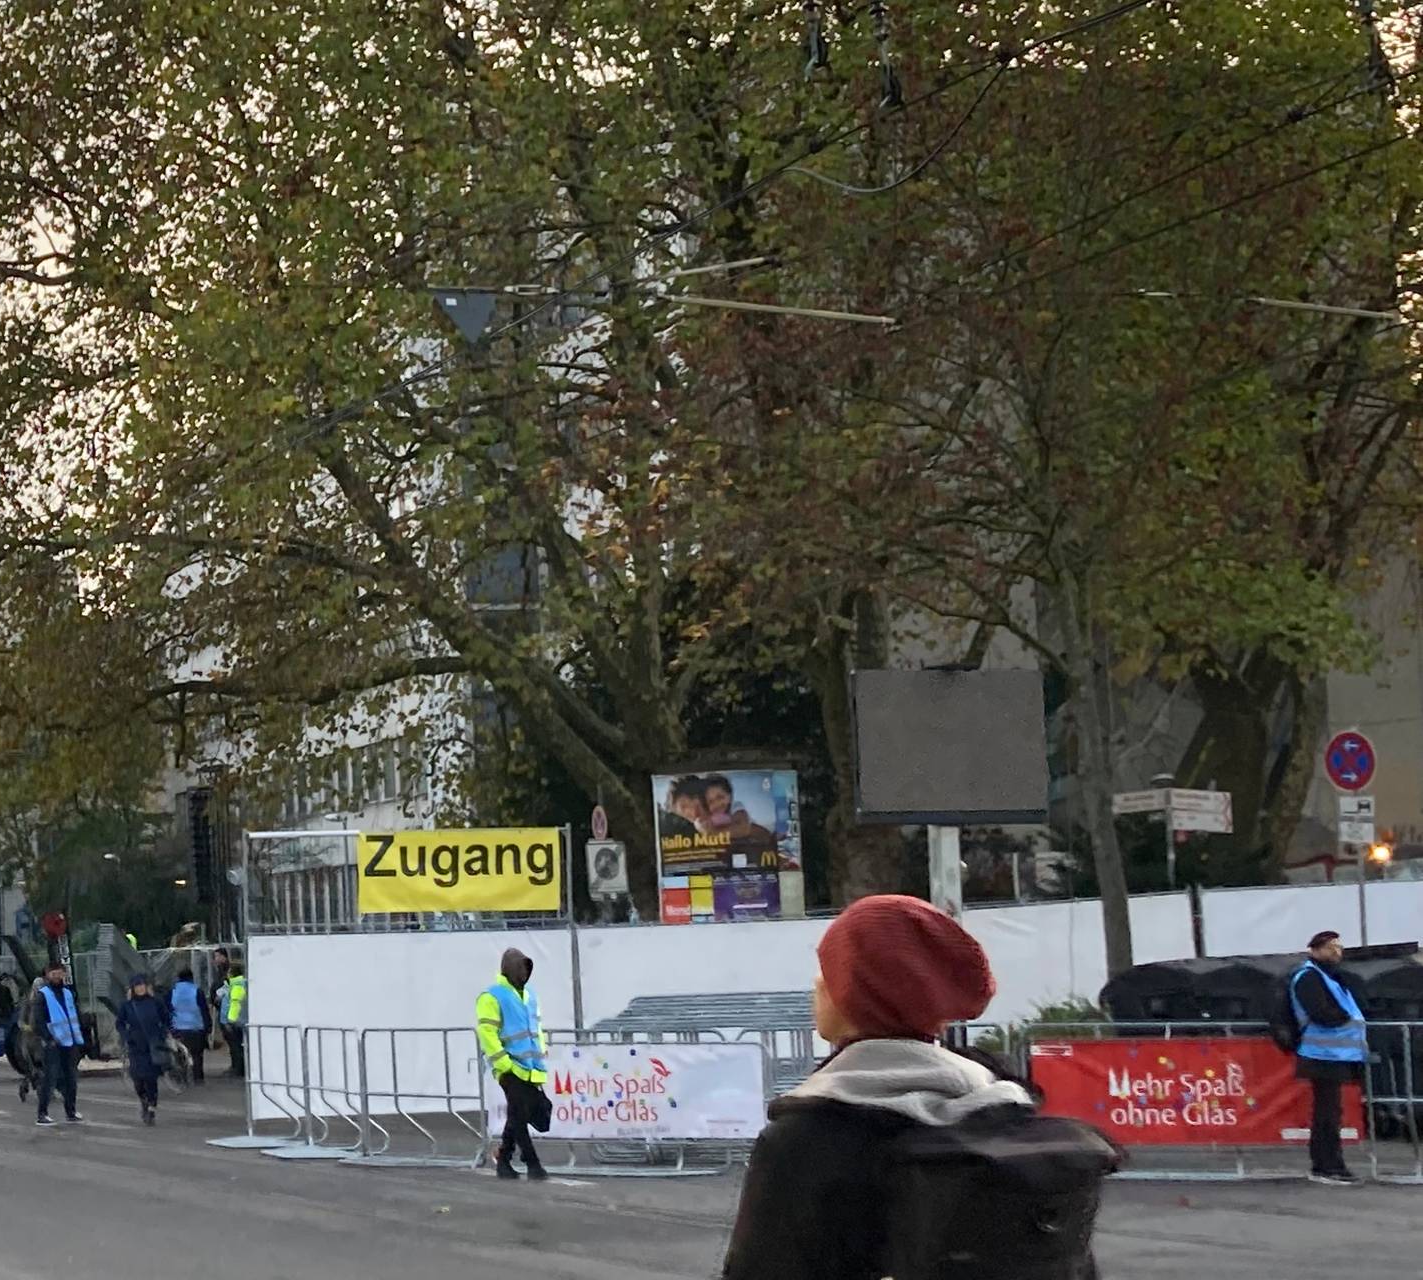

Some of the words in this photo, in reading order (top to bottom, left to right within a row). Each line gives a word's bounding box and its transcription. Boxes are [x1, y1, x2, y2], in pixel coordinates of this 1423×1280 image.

[364, 835, 555, 888] Zugang
[554, 1070, 606, 1096] Mehr
[613, 1073, 666, 1102] Spaß
[1109, 1067, 1174, 1097] Mehr
[1180, 1072, 1245, 1102] Spaß
[556, 1100, 609, 1122] ohne
[615, 1099, 659, 1122] Glas
[1111, 1101, 1177, 1126] ohne
[1181, 1101, 1237, 1126] Glas
